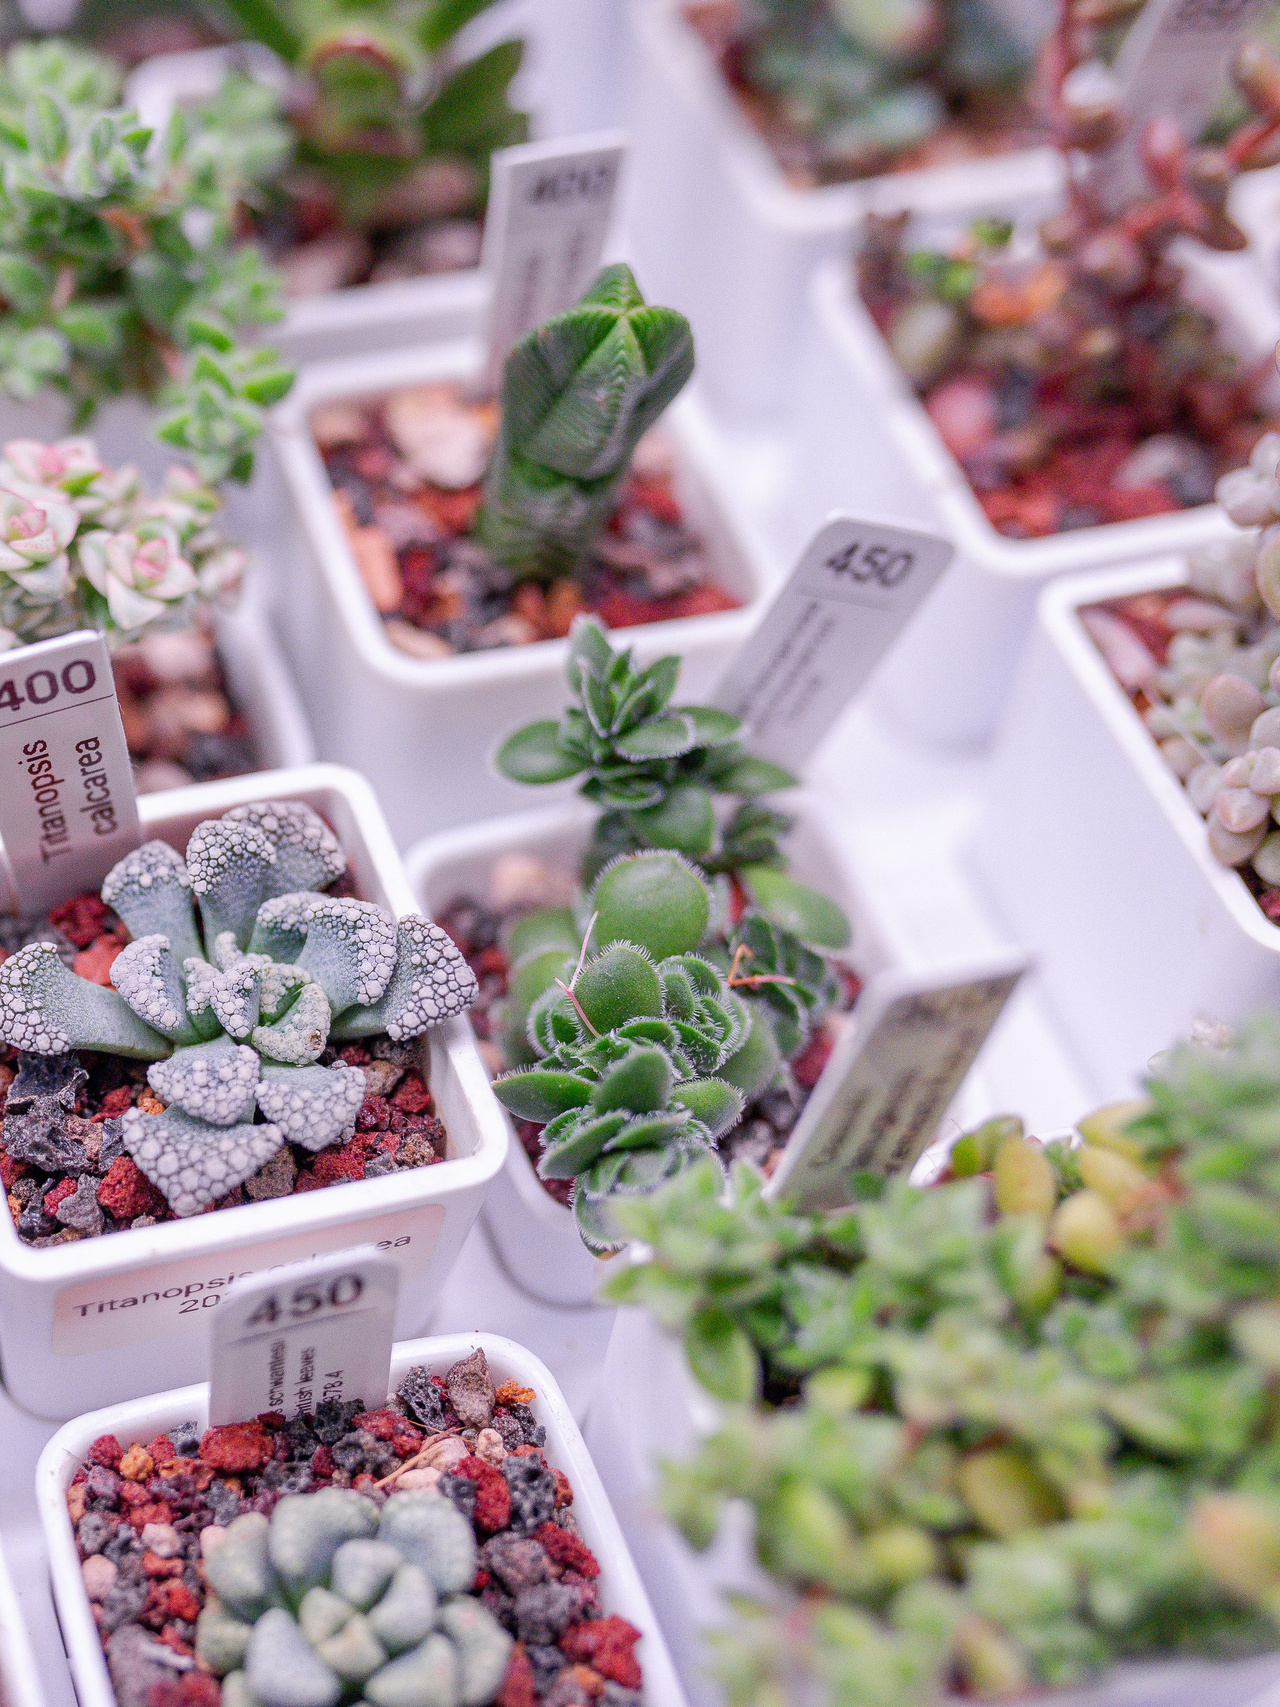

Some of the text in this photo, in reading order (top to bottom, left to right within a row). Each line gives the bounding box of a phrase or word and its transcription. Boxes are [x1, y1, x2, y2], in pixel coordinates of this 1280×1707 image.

[823, 540, 915, 589] 450
[17, 739, 71, 865] Titanopsis
[75, 736, 118, 836] calcarea
[246, 1272, 366, 1329] 450
[294, 1346, 316, 1384] leaves
